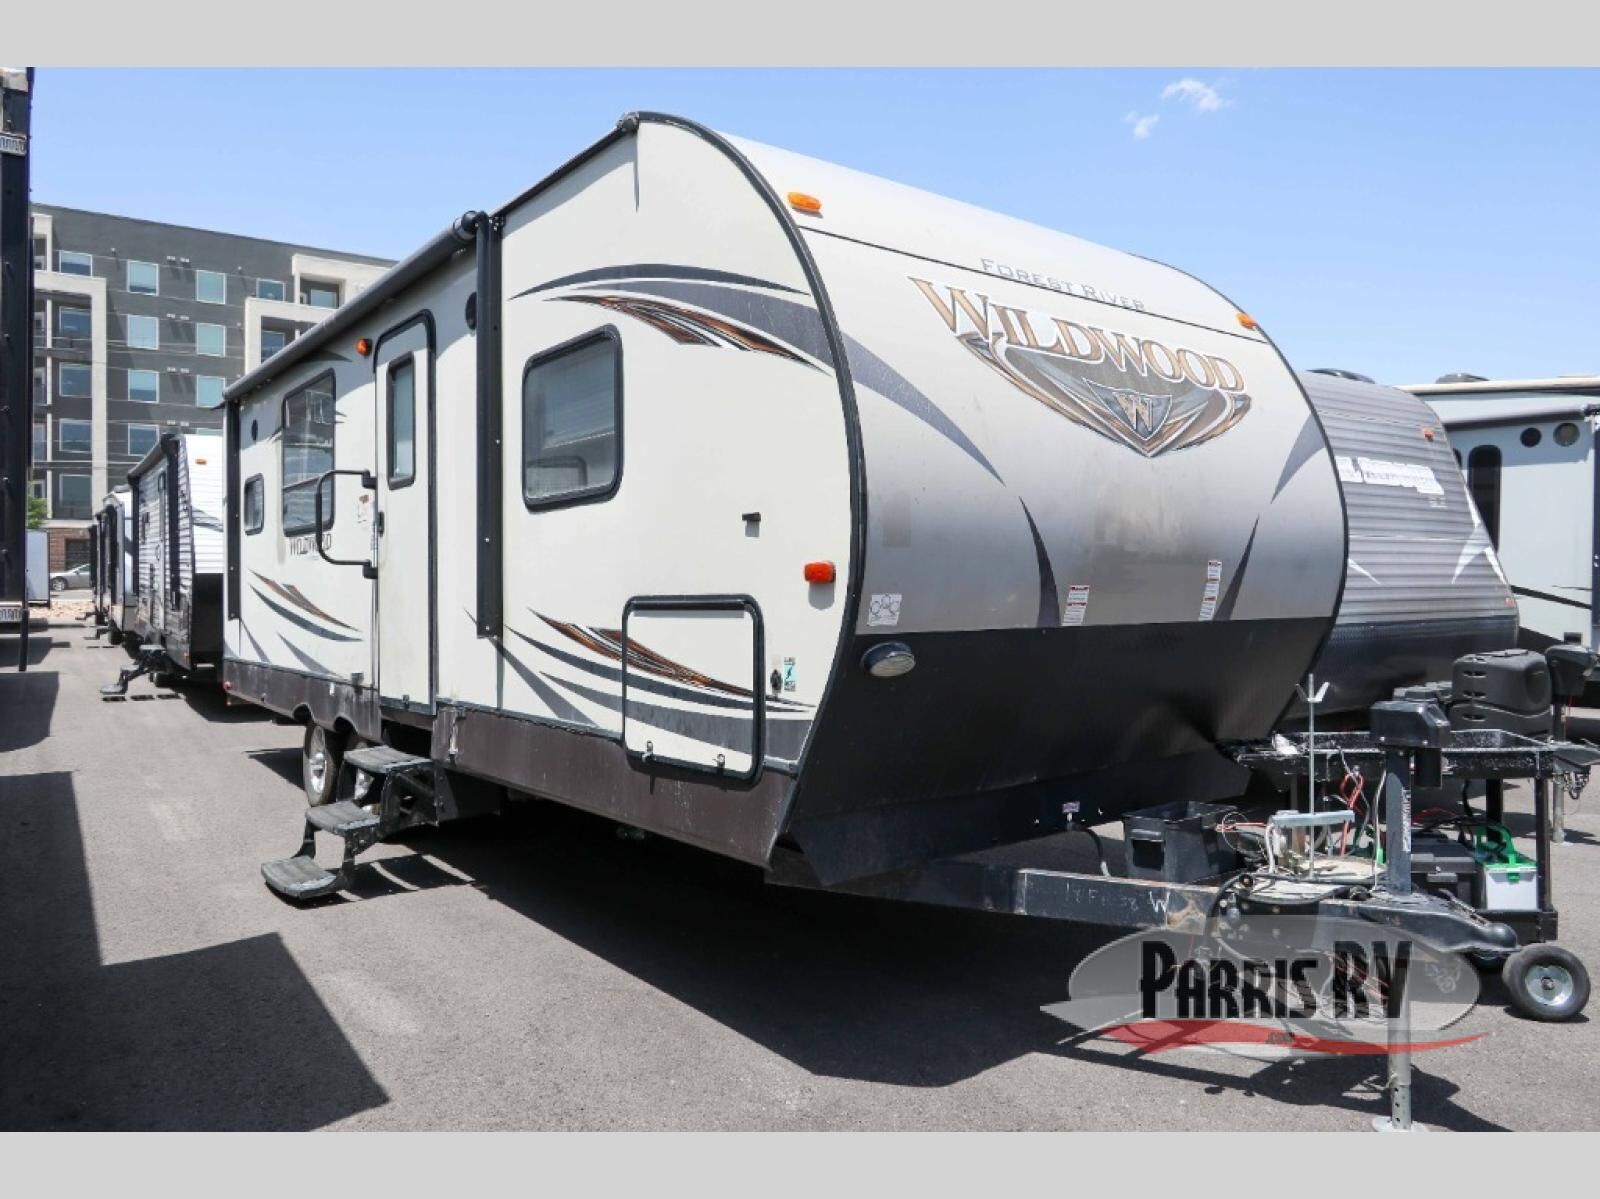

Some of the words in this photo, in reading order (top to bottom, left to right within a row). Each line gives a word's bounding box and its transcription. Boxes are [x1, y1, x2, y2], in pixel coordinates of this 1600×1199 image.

[981, 258, 1073, 292] FOREST
[1081, 284, 1145, 311] RIVER
[907, 276, 1246, 390] WILDWOOD
